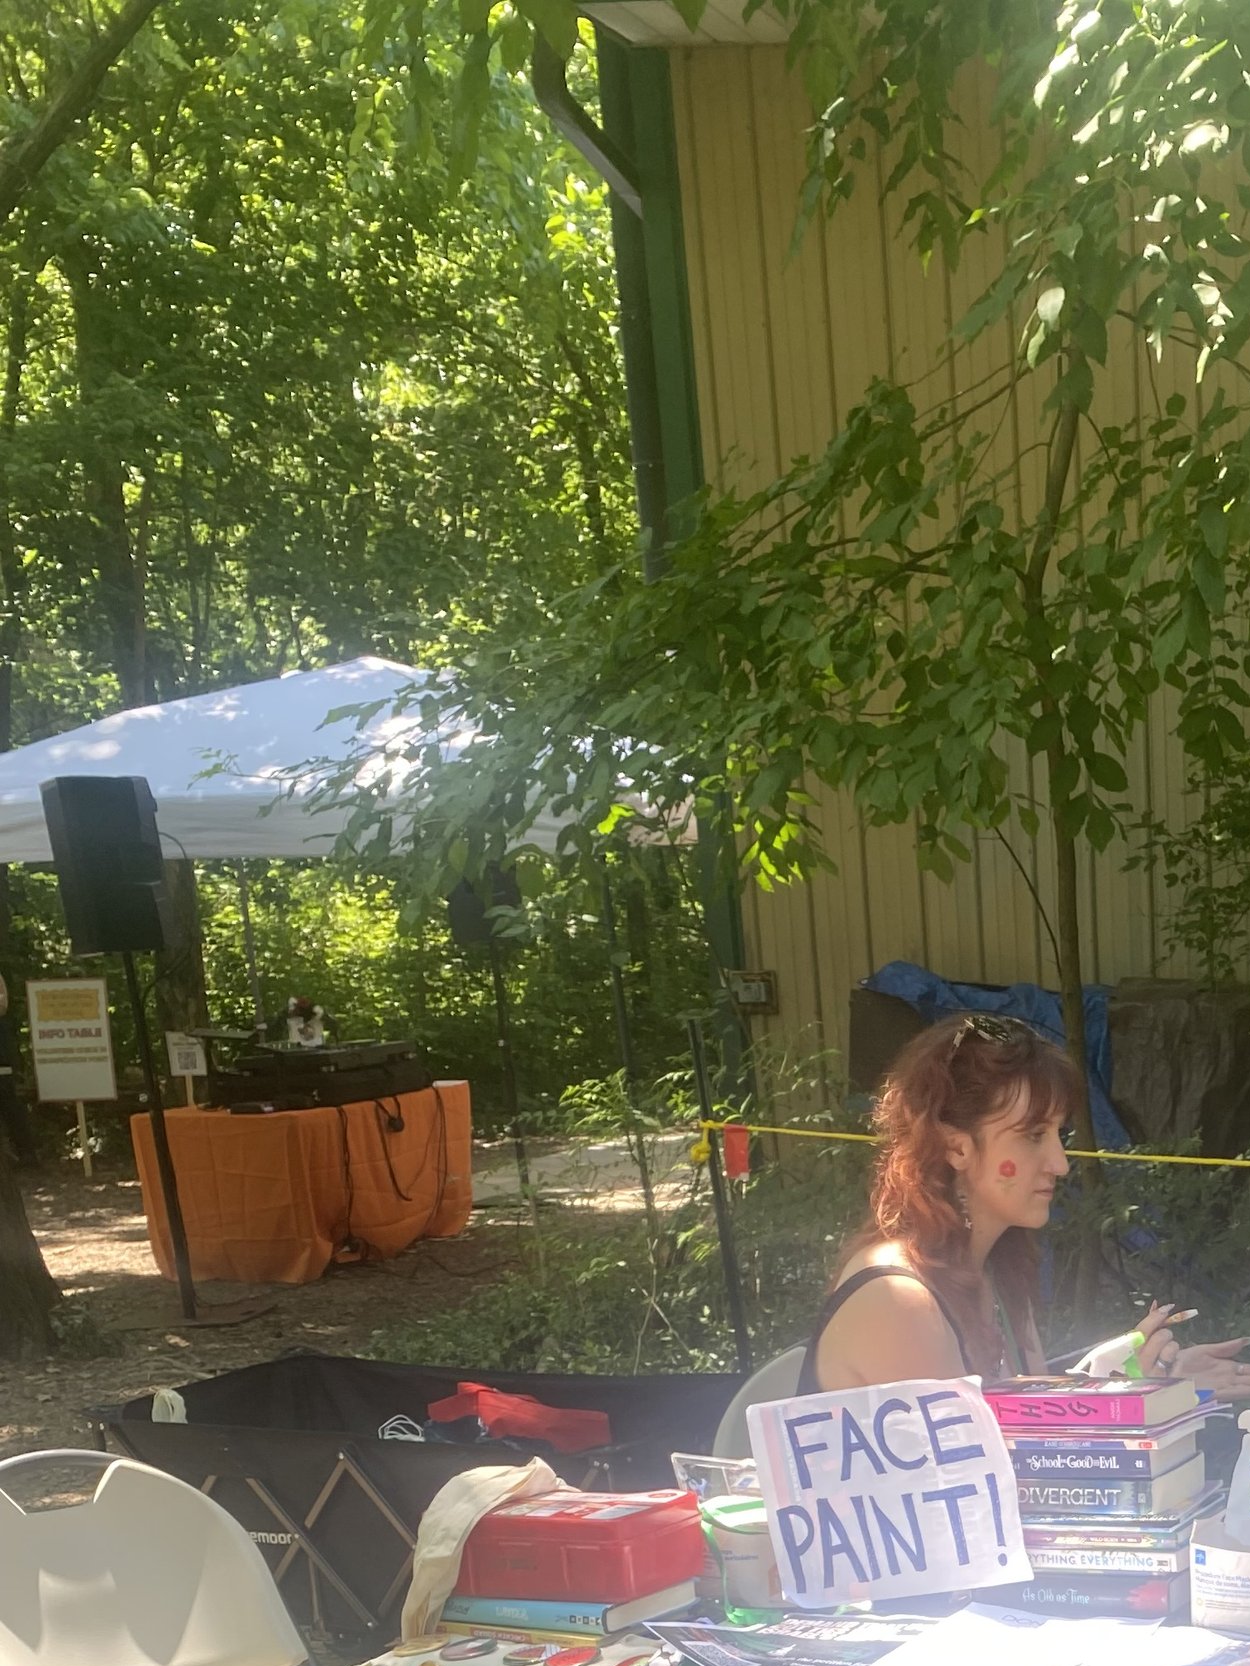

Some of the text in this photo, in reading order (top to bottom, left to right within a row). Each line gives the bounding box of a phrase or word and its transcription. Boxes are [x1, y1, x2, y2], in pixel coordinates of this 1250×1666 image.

[784, 1391, 986, 1490] FACE
[1016, 1486, 1122, 1506] DIVERGENT
[249, 1531, 292, 1545] emoor
[776, 1473, 1008, 1594] PAINT!
[1080, 1555, 1154, 1567] EVERYTHING
[1022, 1588, 1036, 1601] As
[1037, 1587, 1054, 1602] Old
[1066, 1588, 1090, 1604] Time
